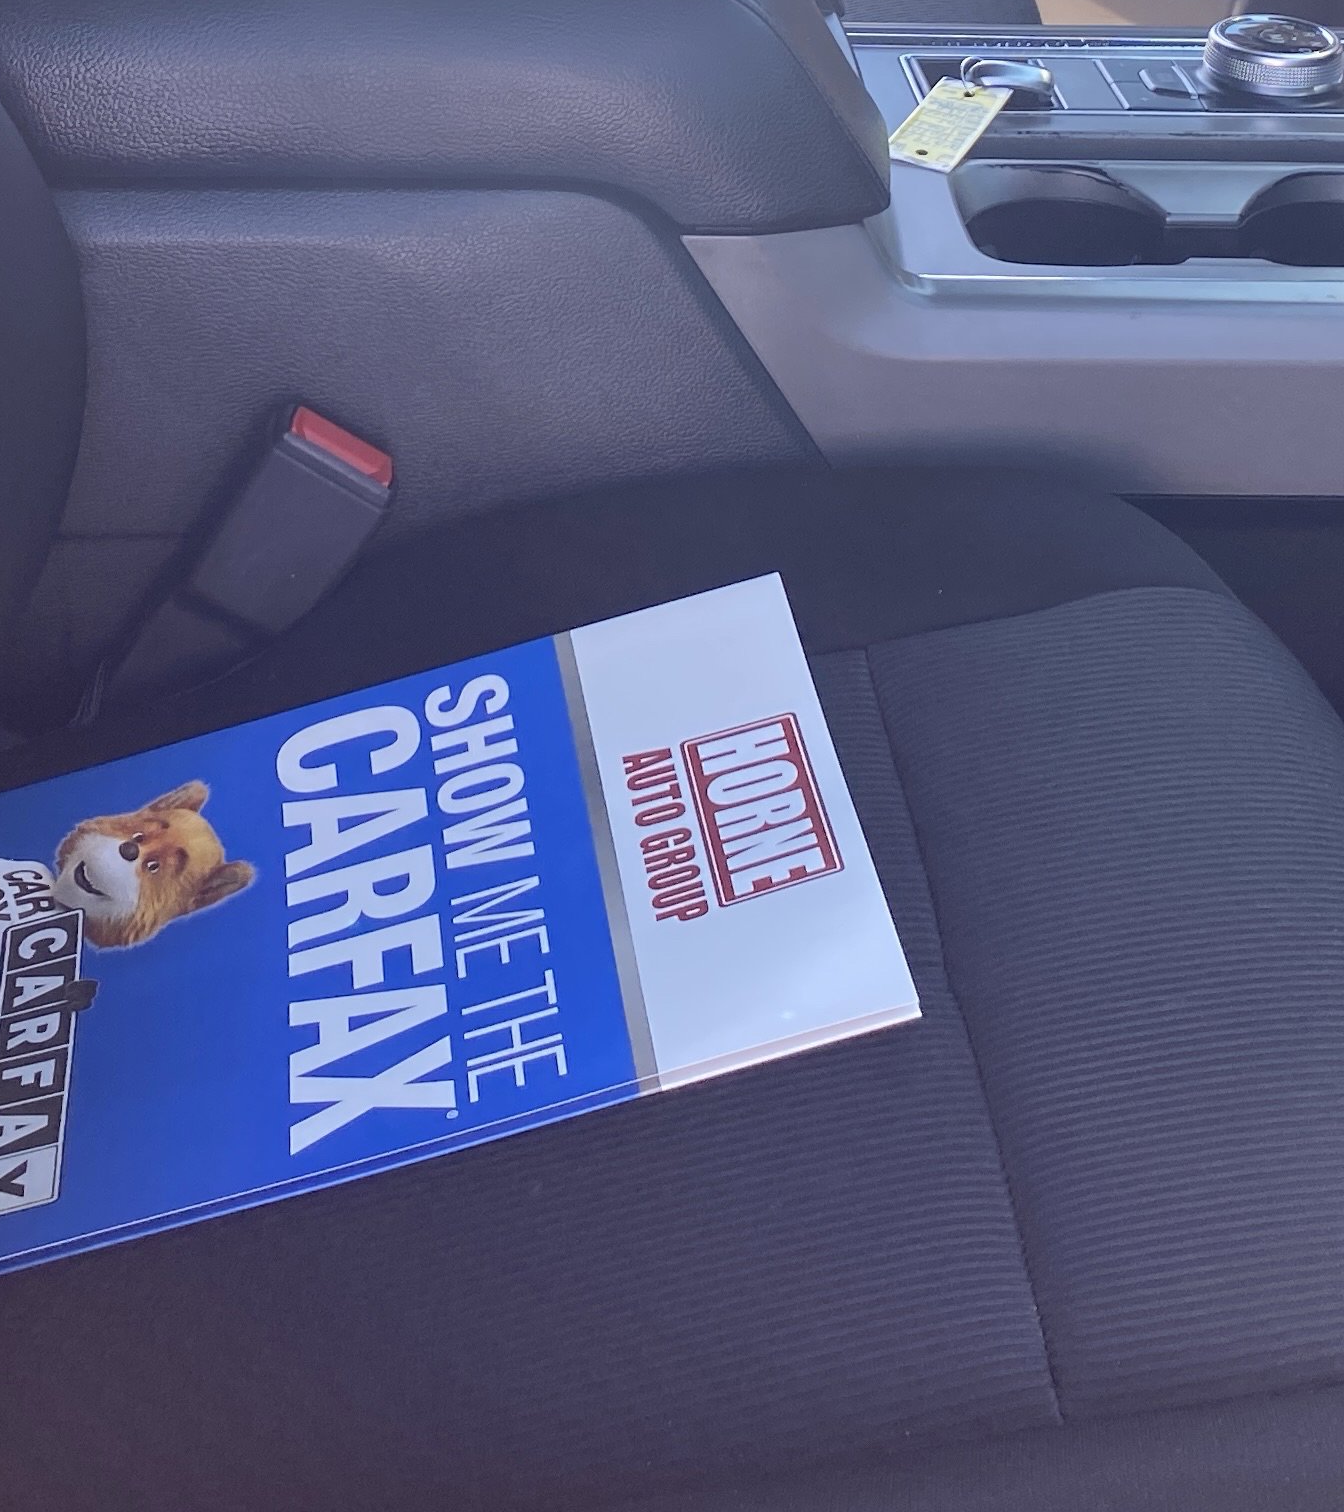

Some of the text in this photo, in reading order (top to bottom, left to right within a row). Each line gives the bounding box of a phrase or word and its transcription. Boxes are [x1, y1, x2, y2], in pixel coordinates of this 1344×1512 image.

[2, 869, 57, 921] CAR
[424, 673, 568, 1104] SHOW ME THE
[622, 747, 709, 922] AUTO GROUP
[696, 721, 827, 898] HORNE
[275, 704, 457, 1156] CARFAX
